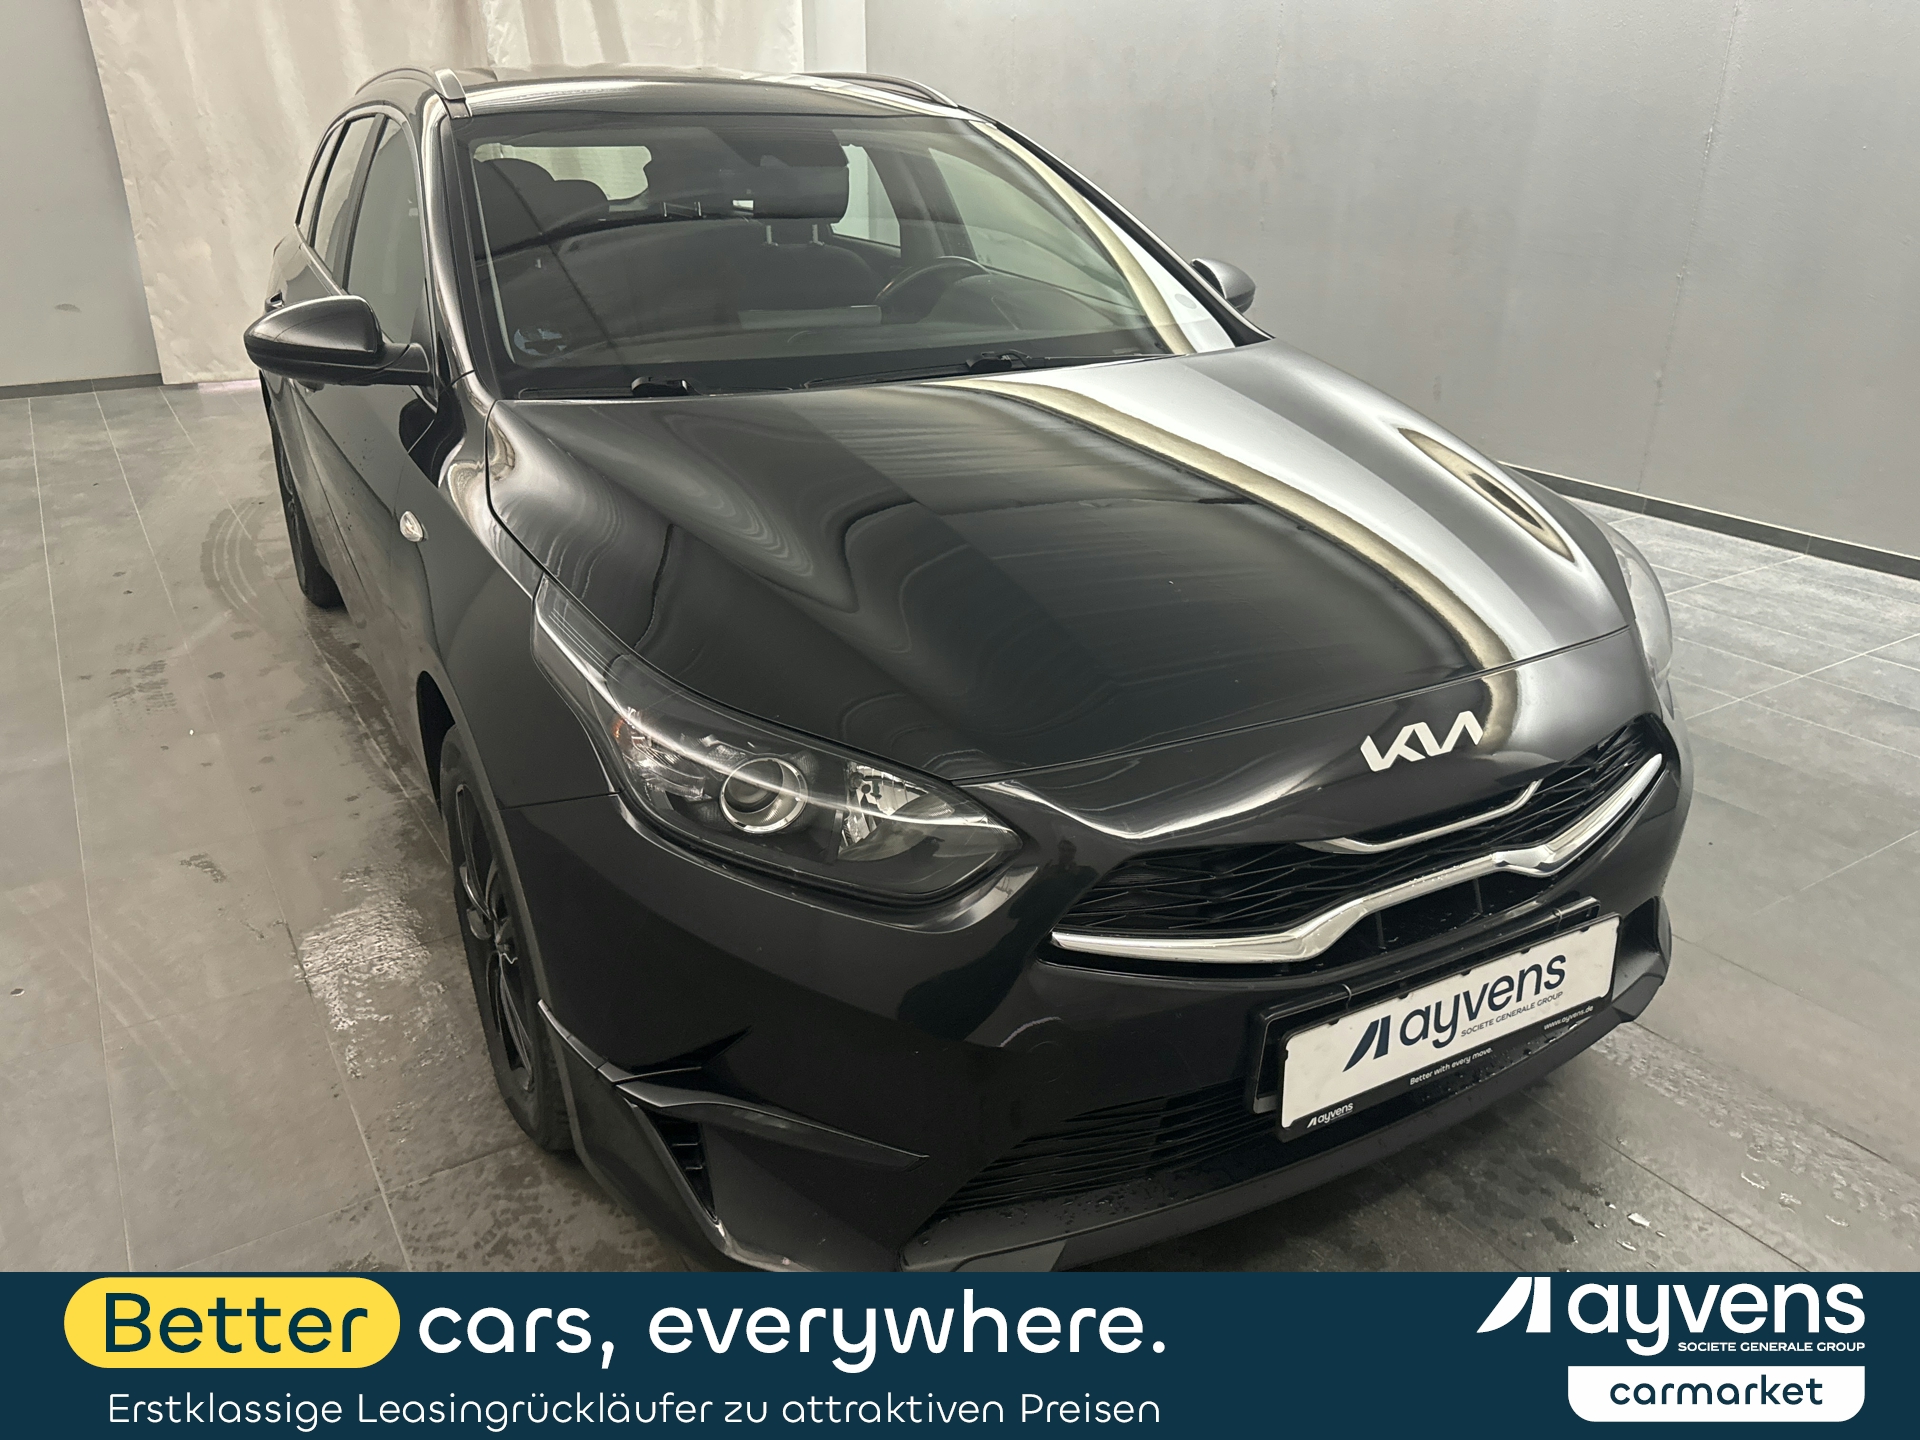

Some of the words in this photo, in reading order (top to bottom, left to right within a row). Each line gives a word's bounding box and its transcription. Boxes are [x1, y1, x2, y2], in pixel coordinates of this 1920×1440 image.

[1400, 954, 1567, 1049] ayvens
[1460, 1018, 1494, 1037] SOCIETE
[1496, 1002, 1536, 1022] GENERALE
[1536, 991, 1564, 1007] GROUP
[1543, 1005, 1594, 1030] www.ayvens.de
[1409, 1071, 1433, 1086] Better
[1434, 1063, 1450, 1075] with
[1451, 1055, 1472, 1068] every
[1317, 1102, 1354, 1124] ayvens
